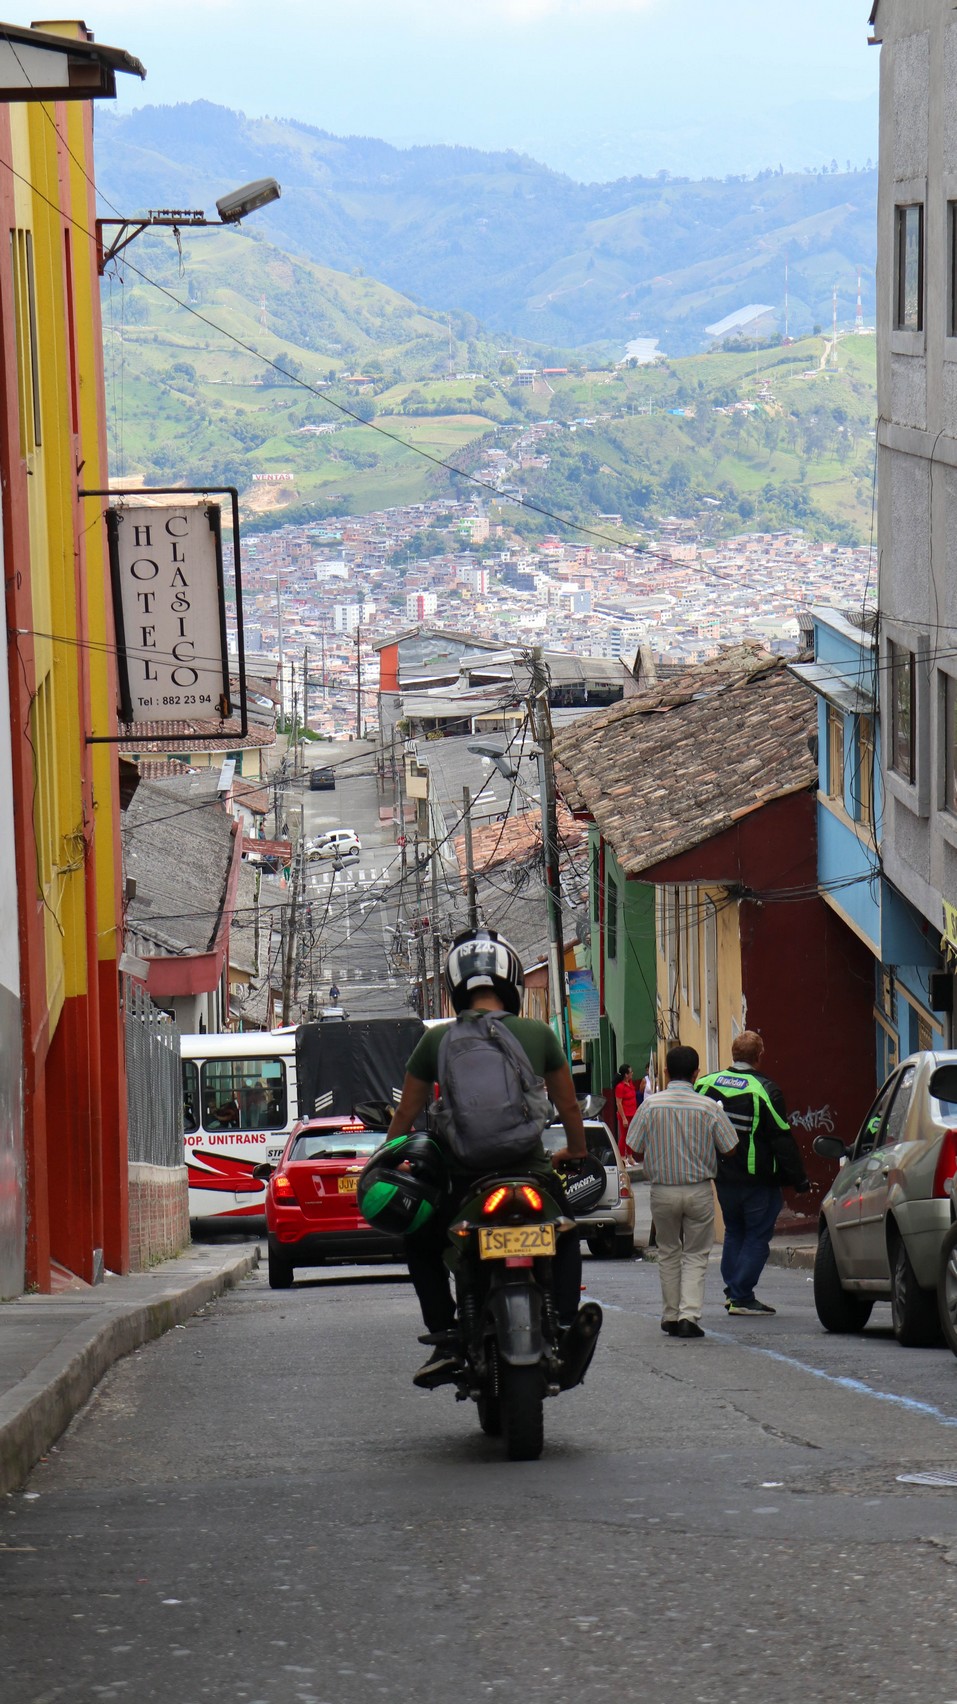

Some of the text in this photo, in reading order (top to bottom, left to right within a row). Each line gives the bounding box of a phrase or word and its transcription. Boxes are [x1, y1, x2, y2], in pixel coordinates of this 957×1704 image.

[130, 524, 160, 682] HOTEL
[164, 515, 199, 687] CLASICO
[138, 696, 153, 706] Tel
[162, 696, 181, 706] 882
[184, 694, 196, 704] 23
[198, 694, 212, 704] 94
[460, 942, 494, 957] ISF 22C
[208, 1134, 266, 1146] UNITRANS
